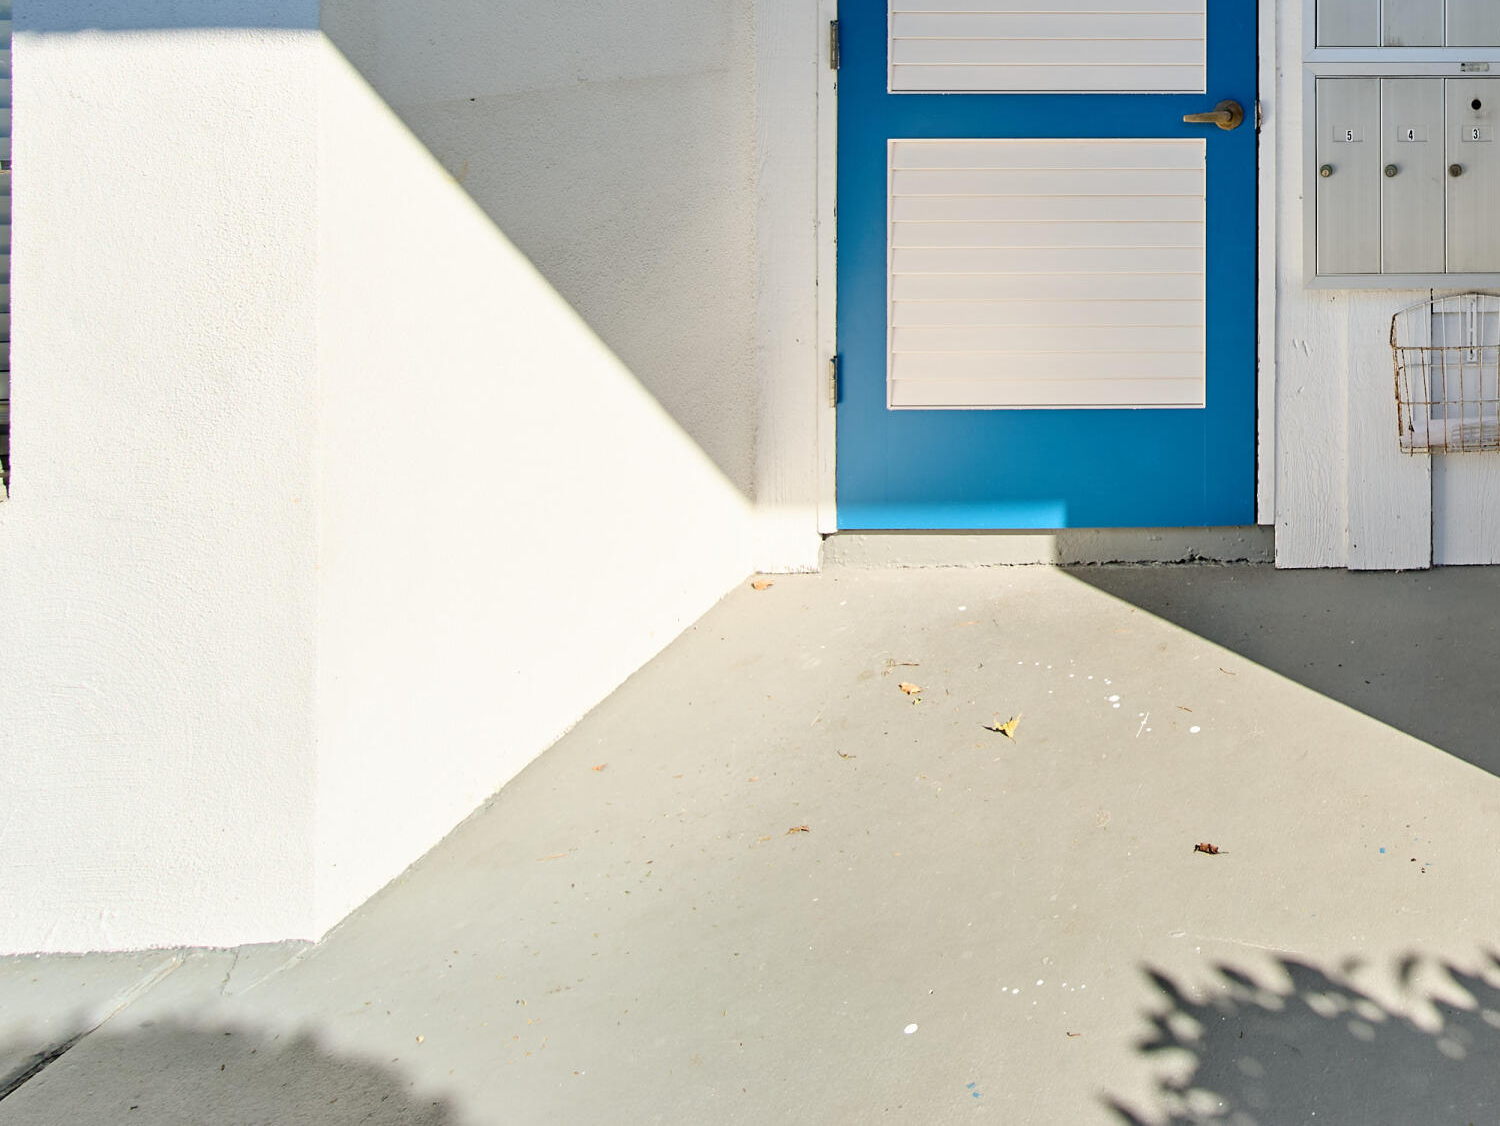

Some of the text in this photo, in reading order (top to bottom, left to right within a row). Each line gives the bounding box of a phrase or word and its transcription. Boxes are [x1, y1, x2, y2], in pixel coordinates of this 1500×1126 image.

[1347, 130, 1352, 141] 5
[1408, 129, 1413, 140] 4
[1473, 129, 1478, 139] 3
